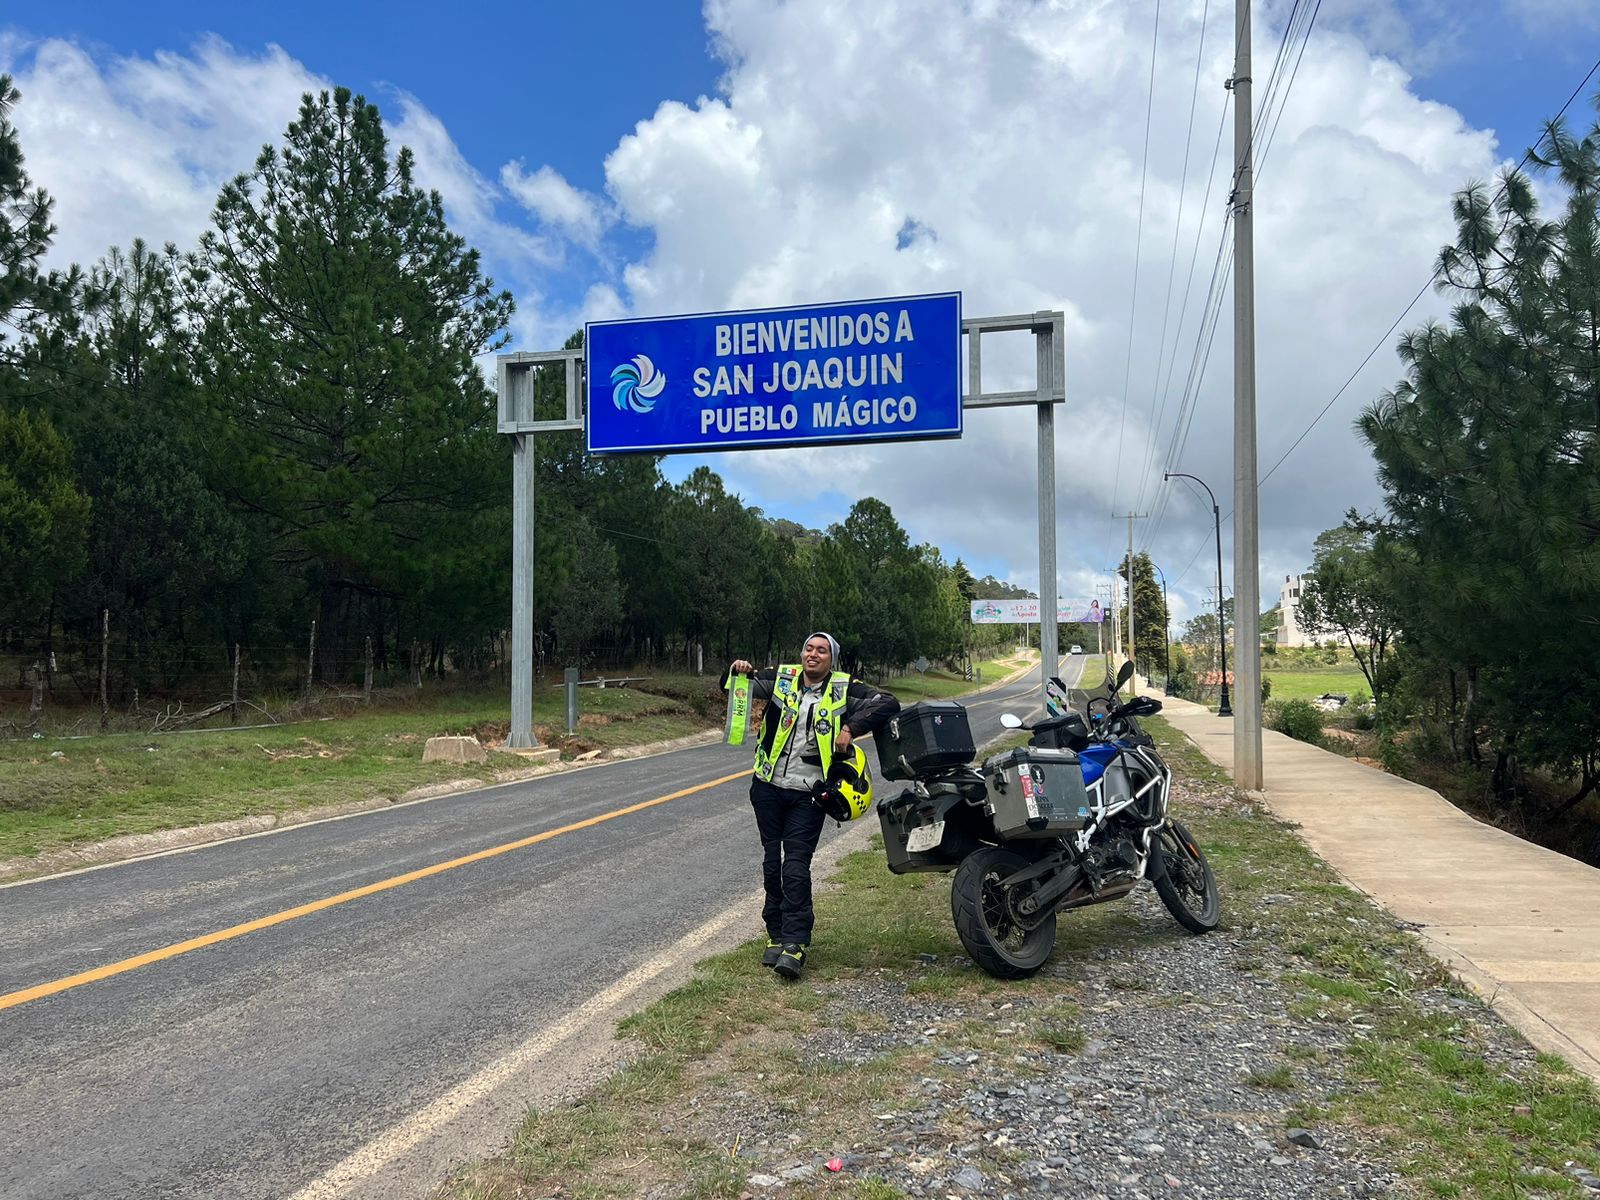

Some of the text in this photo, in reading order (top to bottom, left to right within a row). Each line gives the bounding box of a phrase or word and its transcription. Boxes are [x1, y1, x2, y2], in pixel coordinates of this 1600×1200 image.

[715, 309, 914, 357] BIENVENIDOS A
[693, 352, 903, 398] SAN JOAQUIN
[701, 395, 917, 434] PUEBLO MÁGICO
